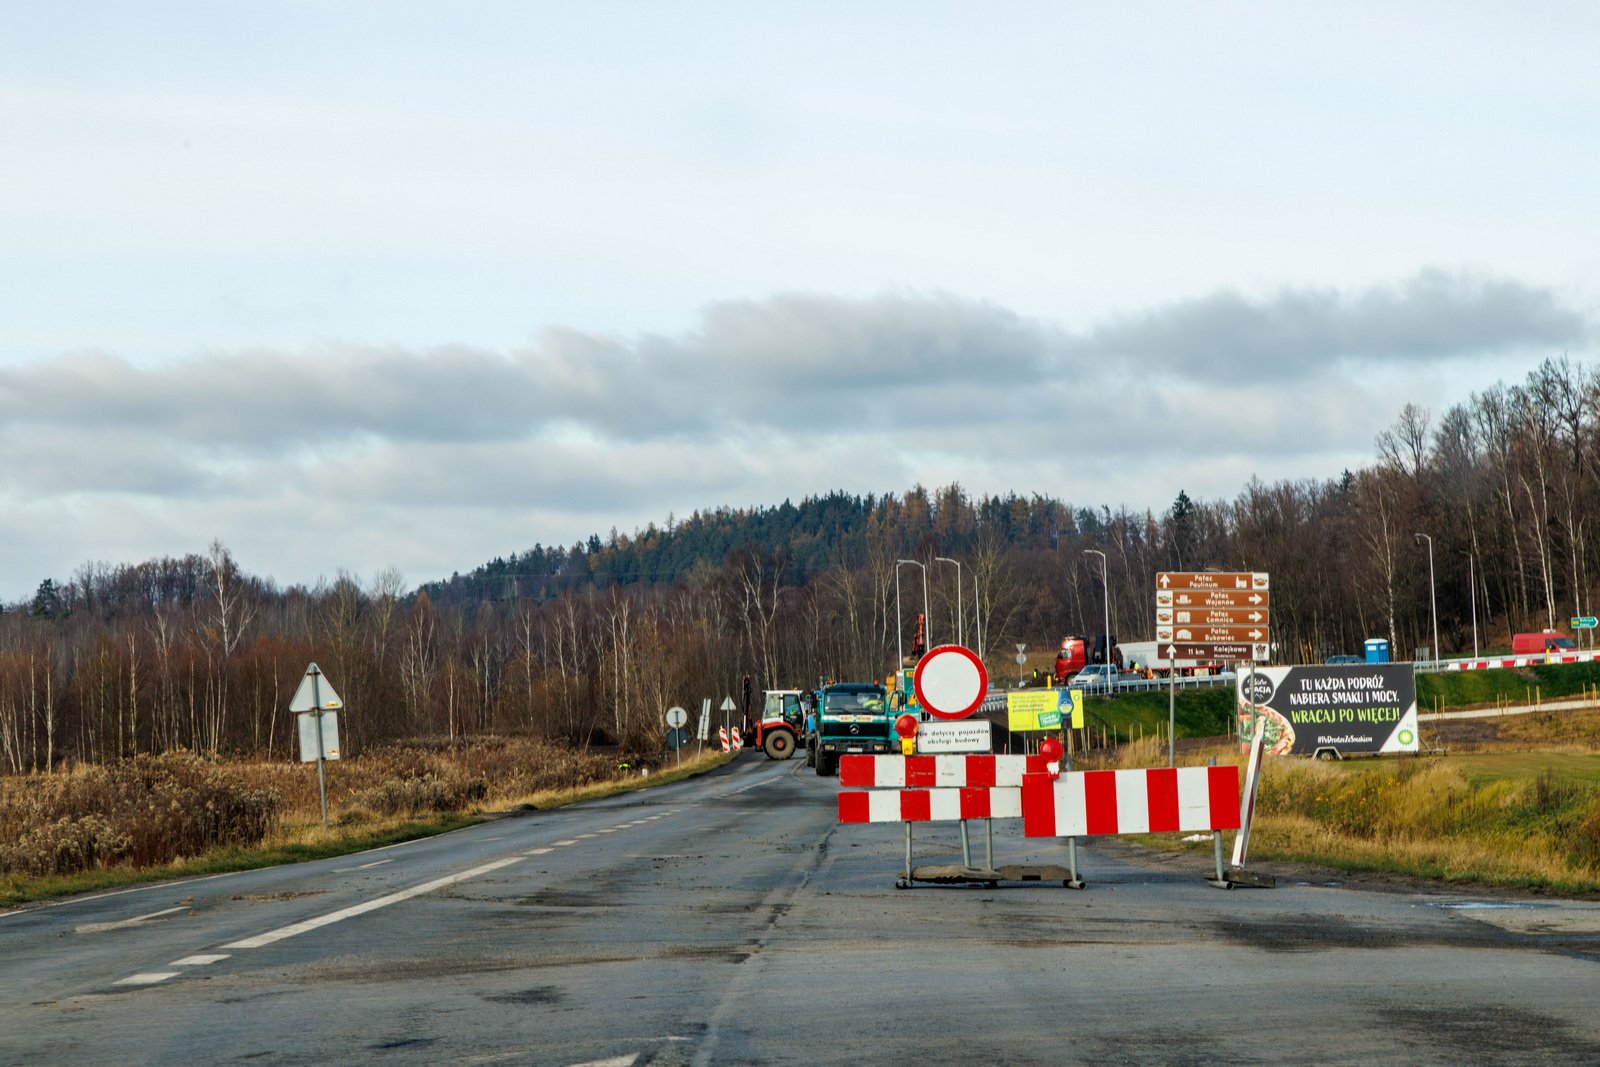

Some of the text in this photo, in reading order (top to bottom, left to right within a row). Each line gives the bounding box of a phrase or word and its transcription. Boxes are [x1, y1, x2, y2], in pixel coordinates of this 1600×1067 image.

[1194, 574, 1213, 582] Pałac
[1213, 646, 1247, 654] Kolejkowo
[1300, 674, 1384, 691] TU KAŻDA PODRÓŻ
[1244, 685, 1272, 694] SACJA
[1289, 690, 1400, 705] NABIERA SMAKU I MOCY.
[1291, 707, 1400, 724] WRACAJ PO WIĘCEJ!
[958, 728, 989, 736] pojazdów
